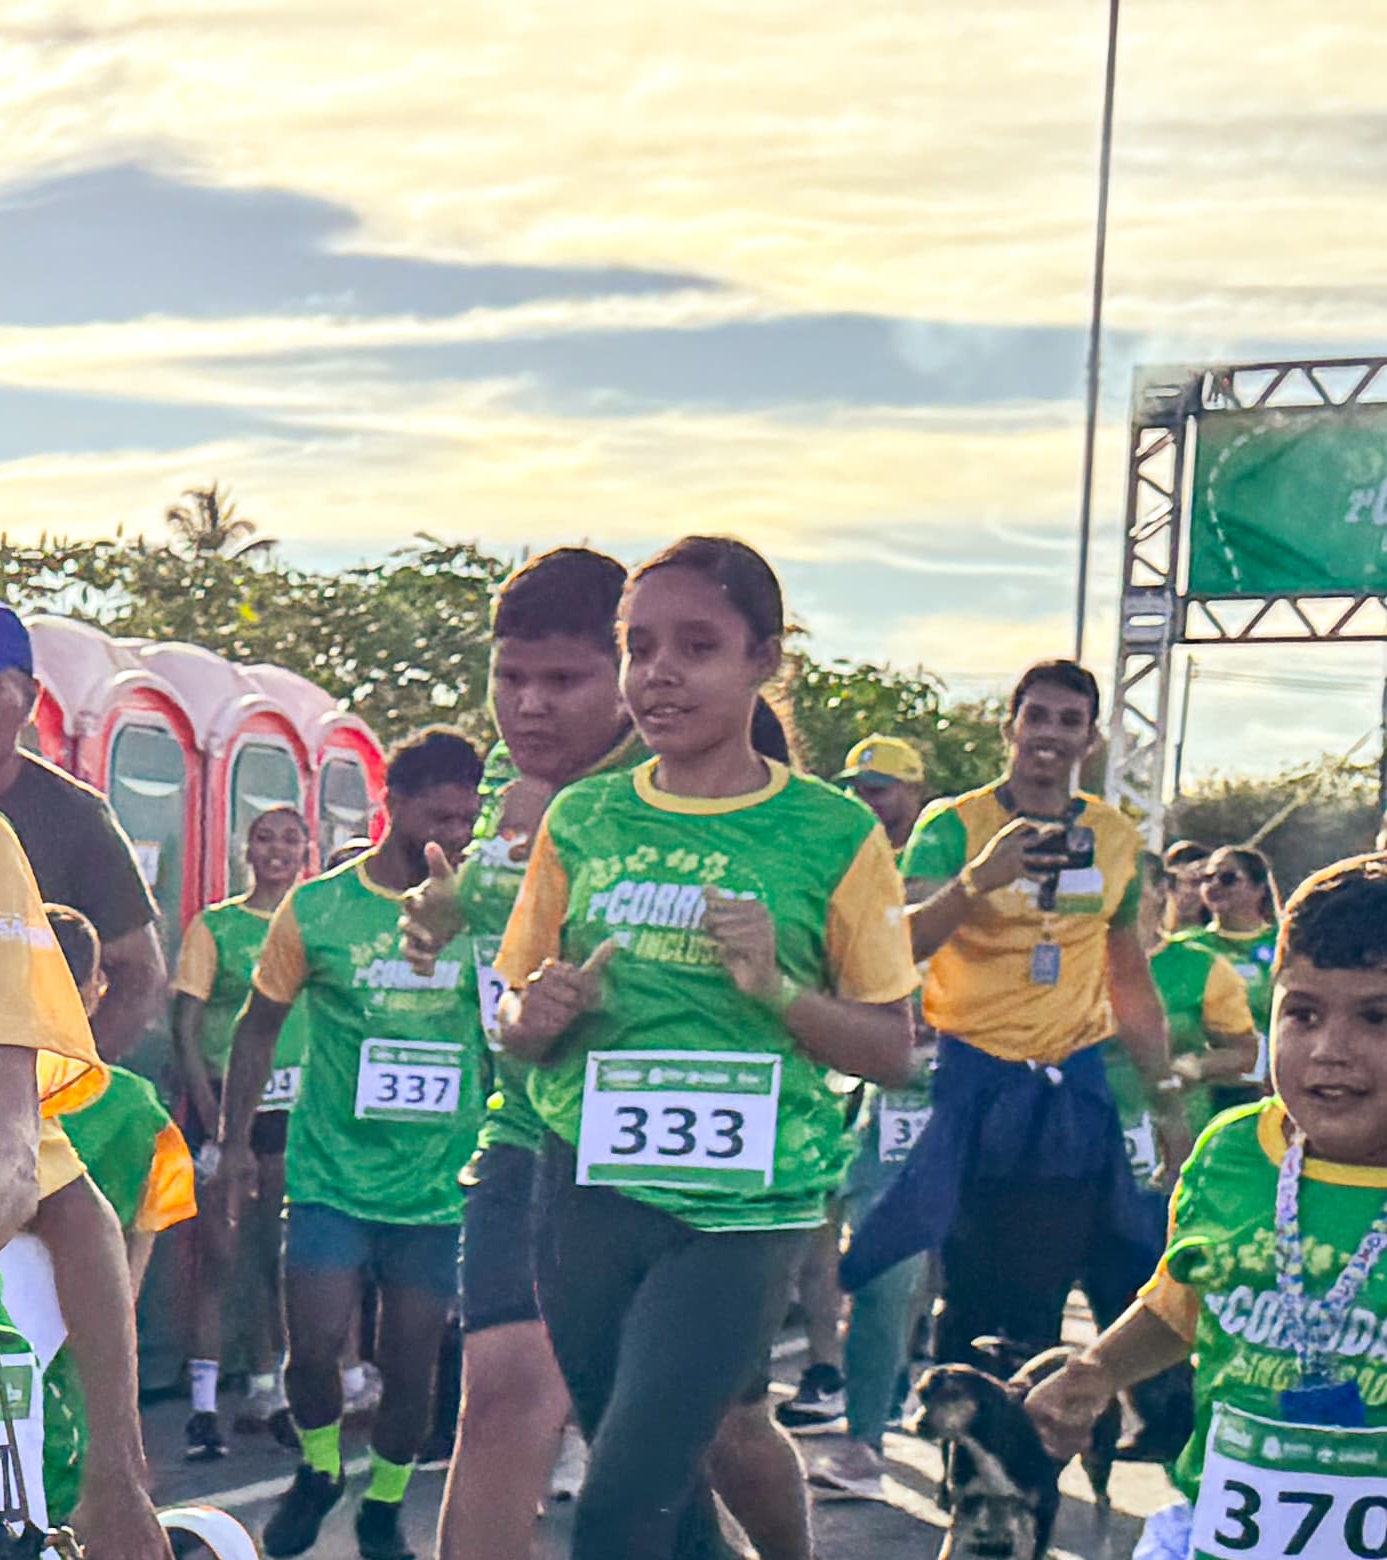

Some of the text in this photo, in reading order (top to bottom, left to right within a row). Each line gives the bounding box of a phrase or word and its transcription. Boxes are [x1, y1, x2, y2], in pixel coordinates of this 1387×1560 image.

[605, 880, 739, 930] CORRI
[377, 1073, 450, 1105] 337
[610, 1106, 744, 1159] 333
[1214, 1479, 1387, 1560] 370
